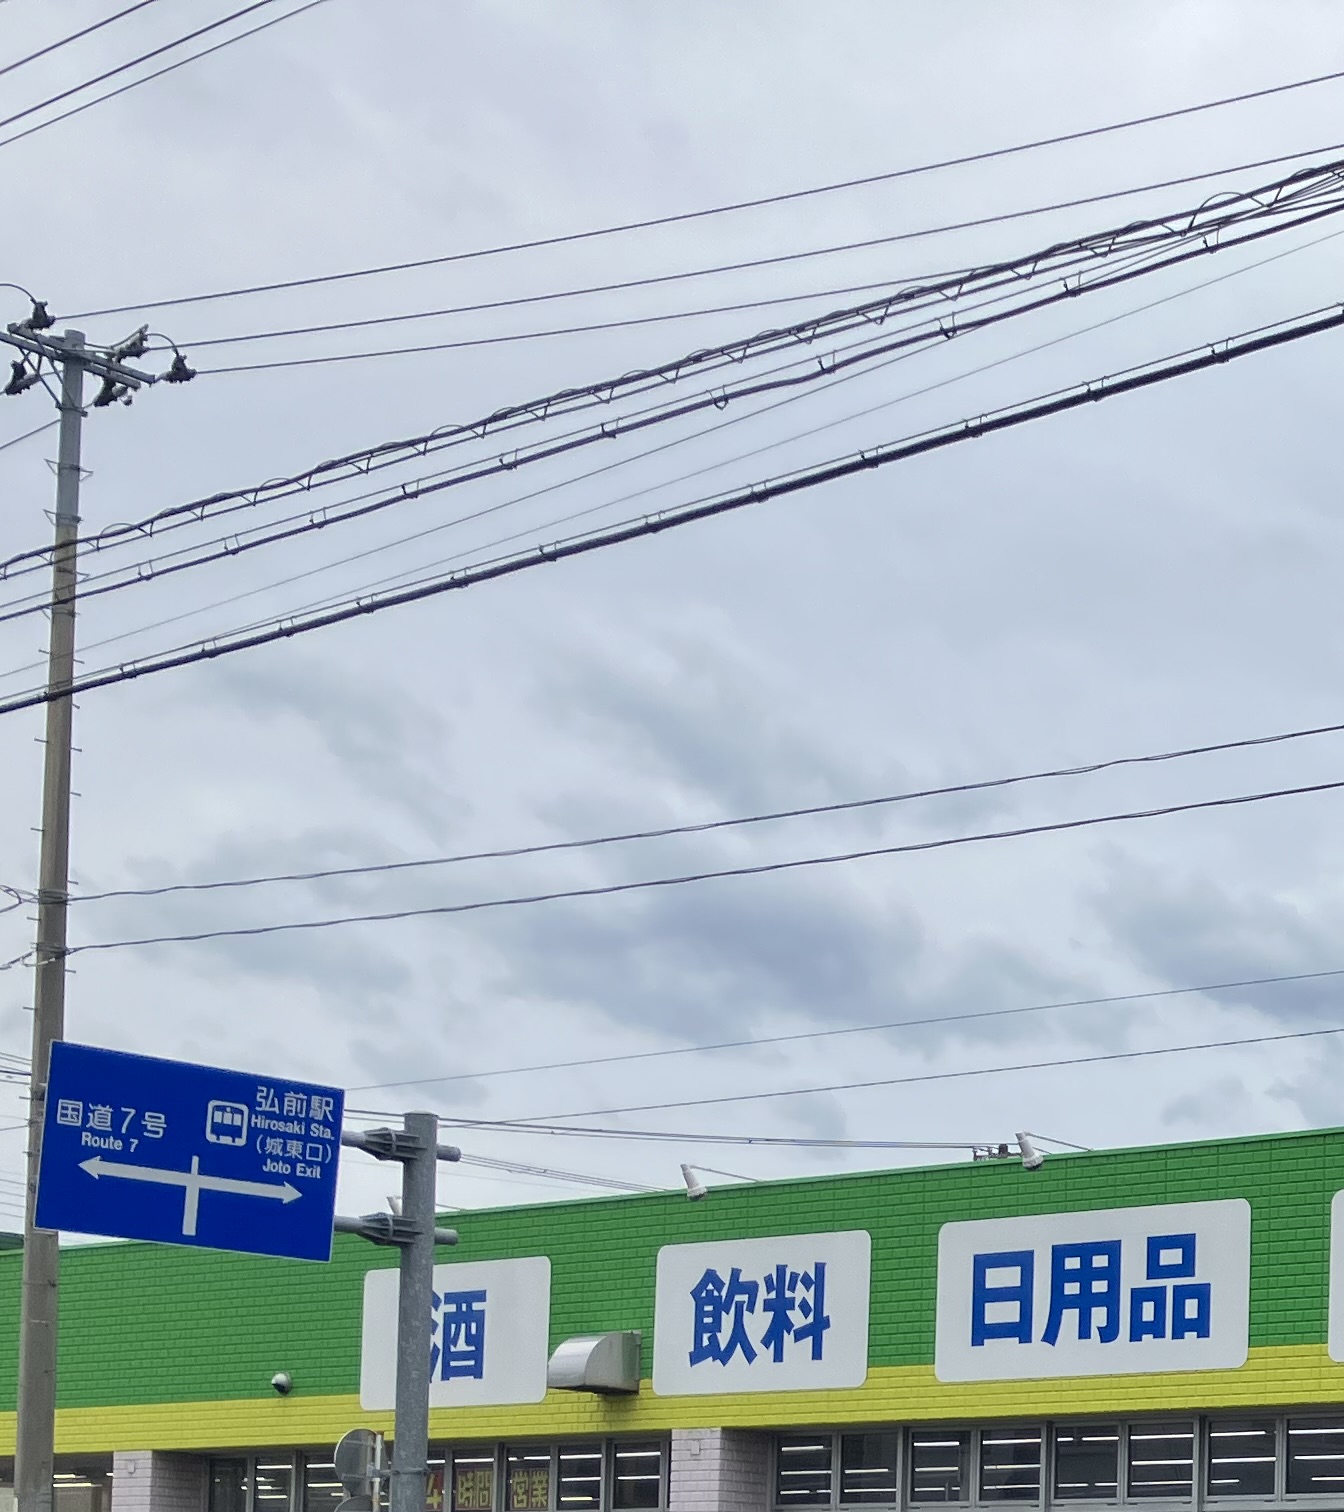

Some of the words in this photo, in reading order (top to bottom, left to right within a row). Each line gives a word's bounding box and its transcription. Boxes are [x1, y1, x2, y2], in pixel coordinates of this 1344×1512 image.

[56, 1099, 168, 1140] 国道7号
[254, 1086, 335, 1123] 弘前駅
[81, 1131, 124, 1151] Route
[129, 1138, 140, 1153] 7
[250, 1114, 306, 1136] Hirosaki
[309, 1122, 336, 1141] Sta.
[262, 1158, 291, 1176] Joto
[296, 1162, 321, 1179] Exit
[969, 1233, 1211, 1347] 日用品
[689, 1262, 831, 1367] 飲料
[429, 1288, 487, 1384] 酒
